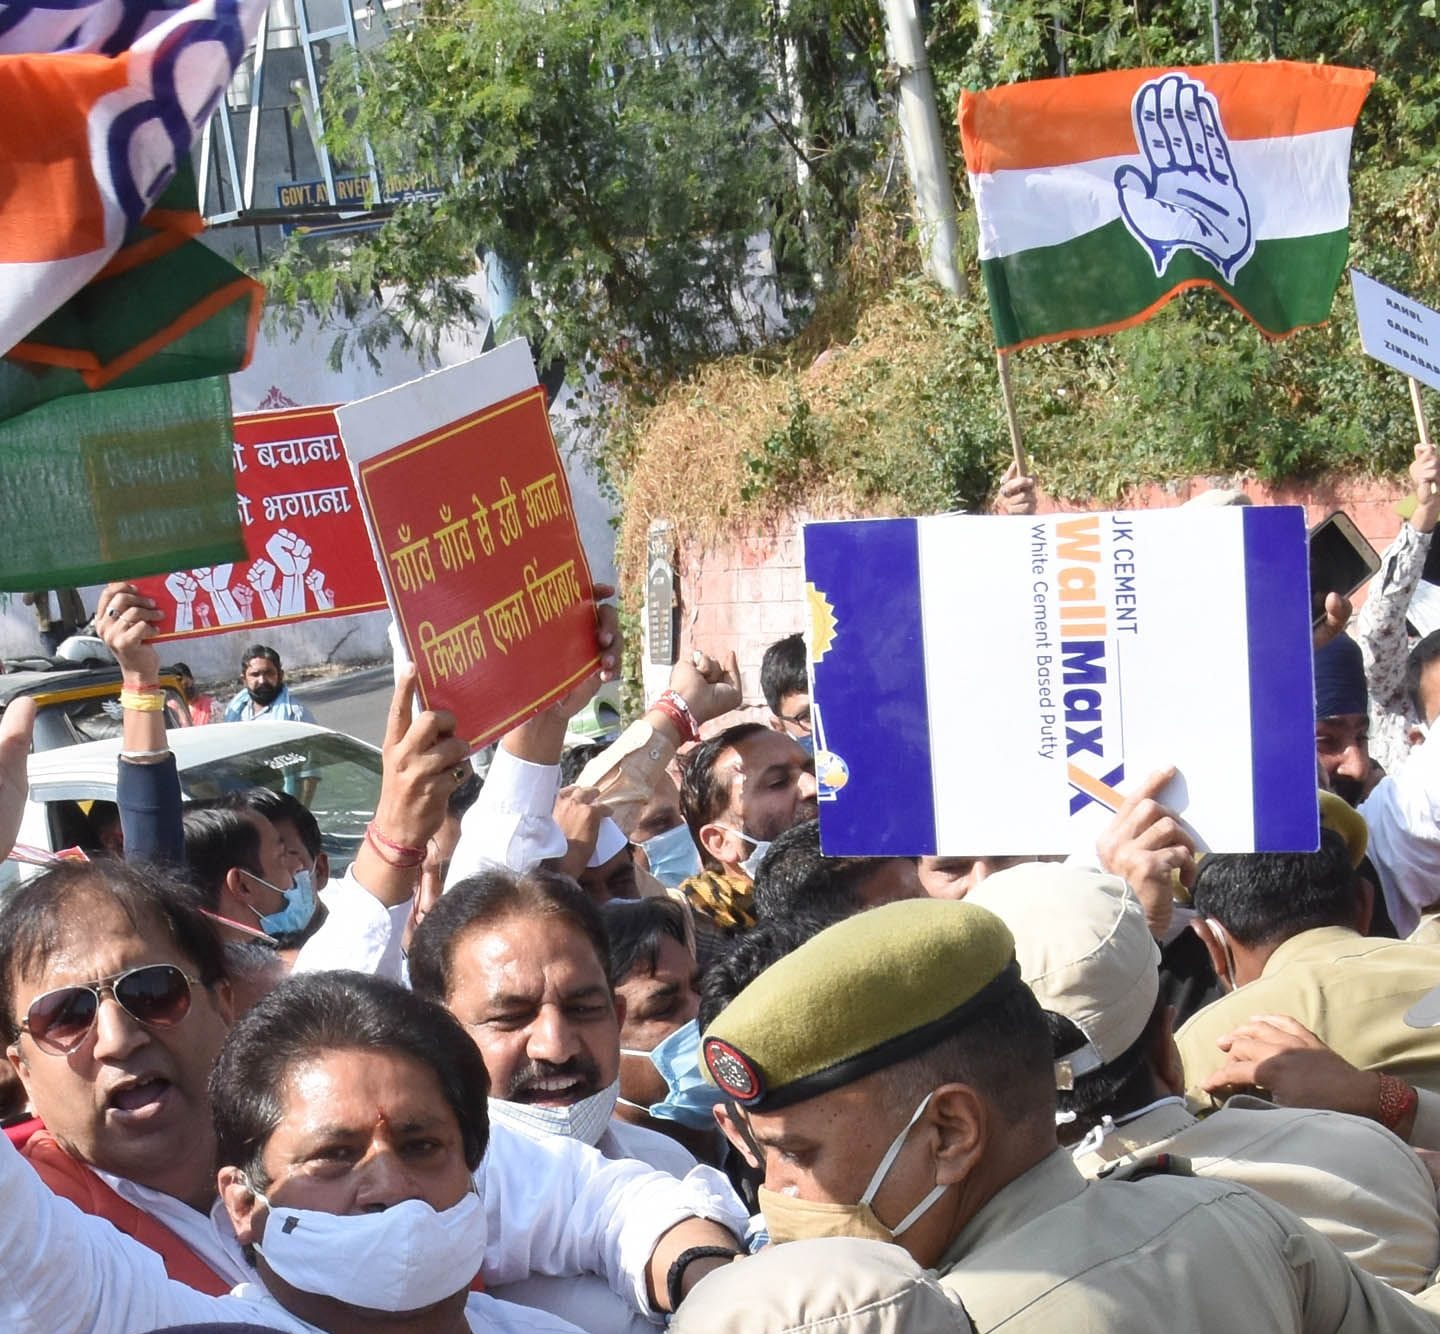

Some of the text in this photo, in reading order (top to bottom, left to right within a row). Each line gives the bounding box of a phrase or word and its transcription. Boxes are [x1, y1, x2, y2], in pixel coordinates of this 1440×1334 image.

[316, 176, 380, 203] AYRVED
[1385, 298, 1423, 323] RAHUL
[1387, 319, 1429, 346] GANDHI
[1383, 340, 1440, 375] ZINDABAD
[253, 435, 341, 469] बचाना
[262, 486, 352, 521] भगाना
[391, 522, 436, 594] गाँव
[433, 504, 477, 573] गाँव
[472, 494, 496, 557] से
[491, 476, 523, 546] उठी
[1112, 515, 1138, 635] JK CEMENT
[418, 556, 582, 688] किसान एकता जिंदाबाद
[1031, 523, 1058, 760] White Cement Based Putty
